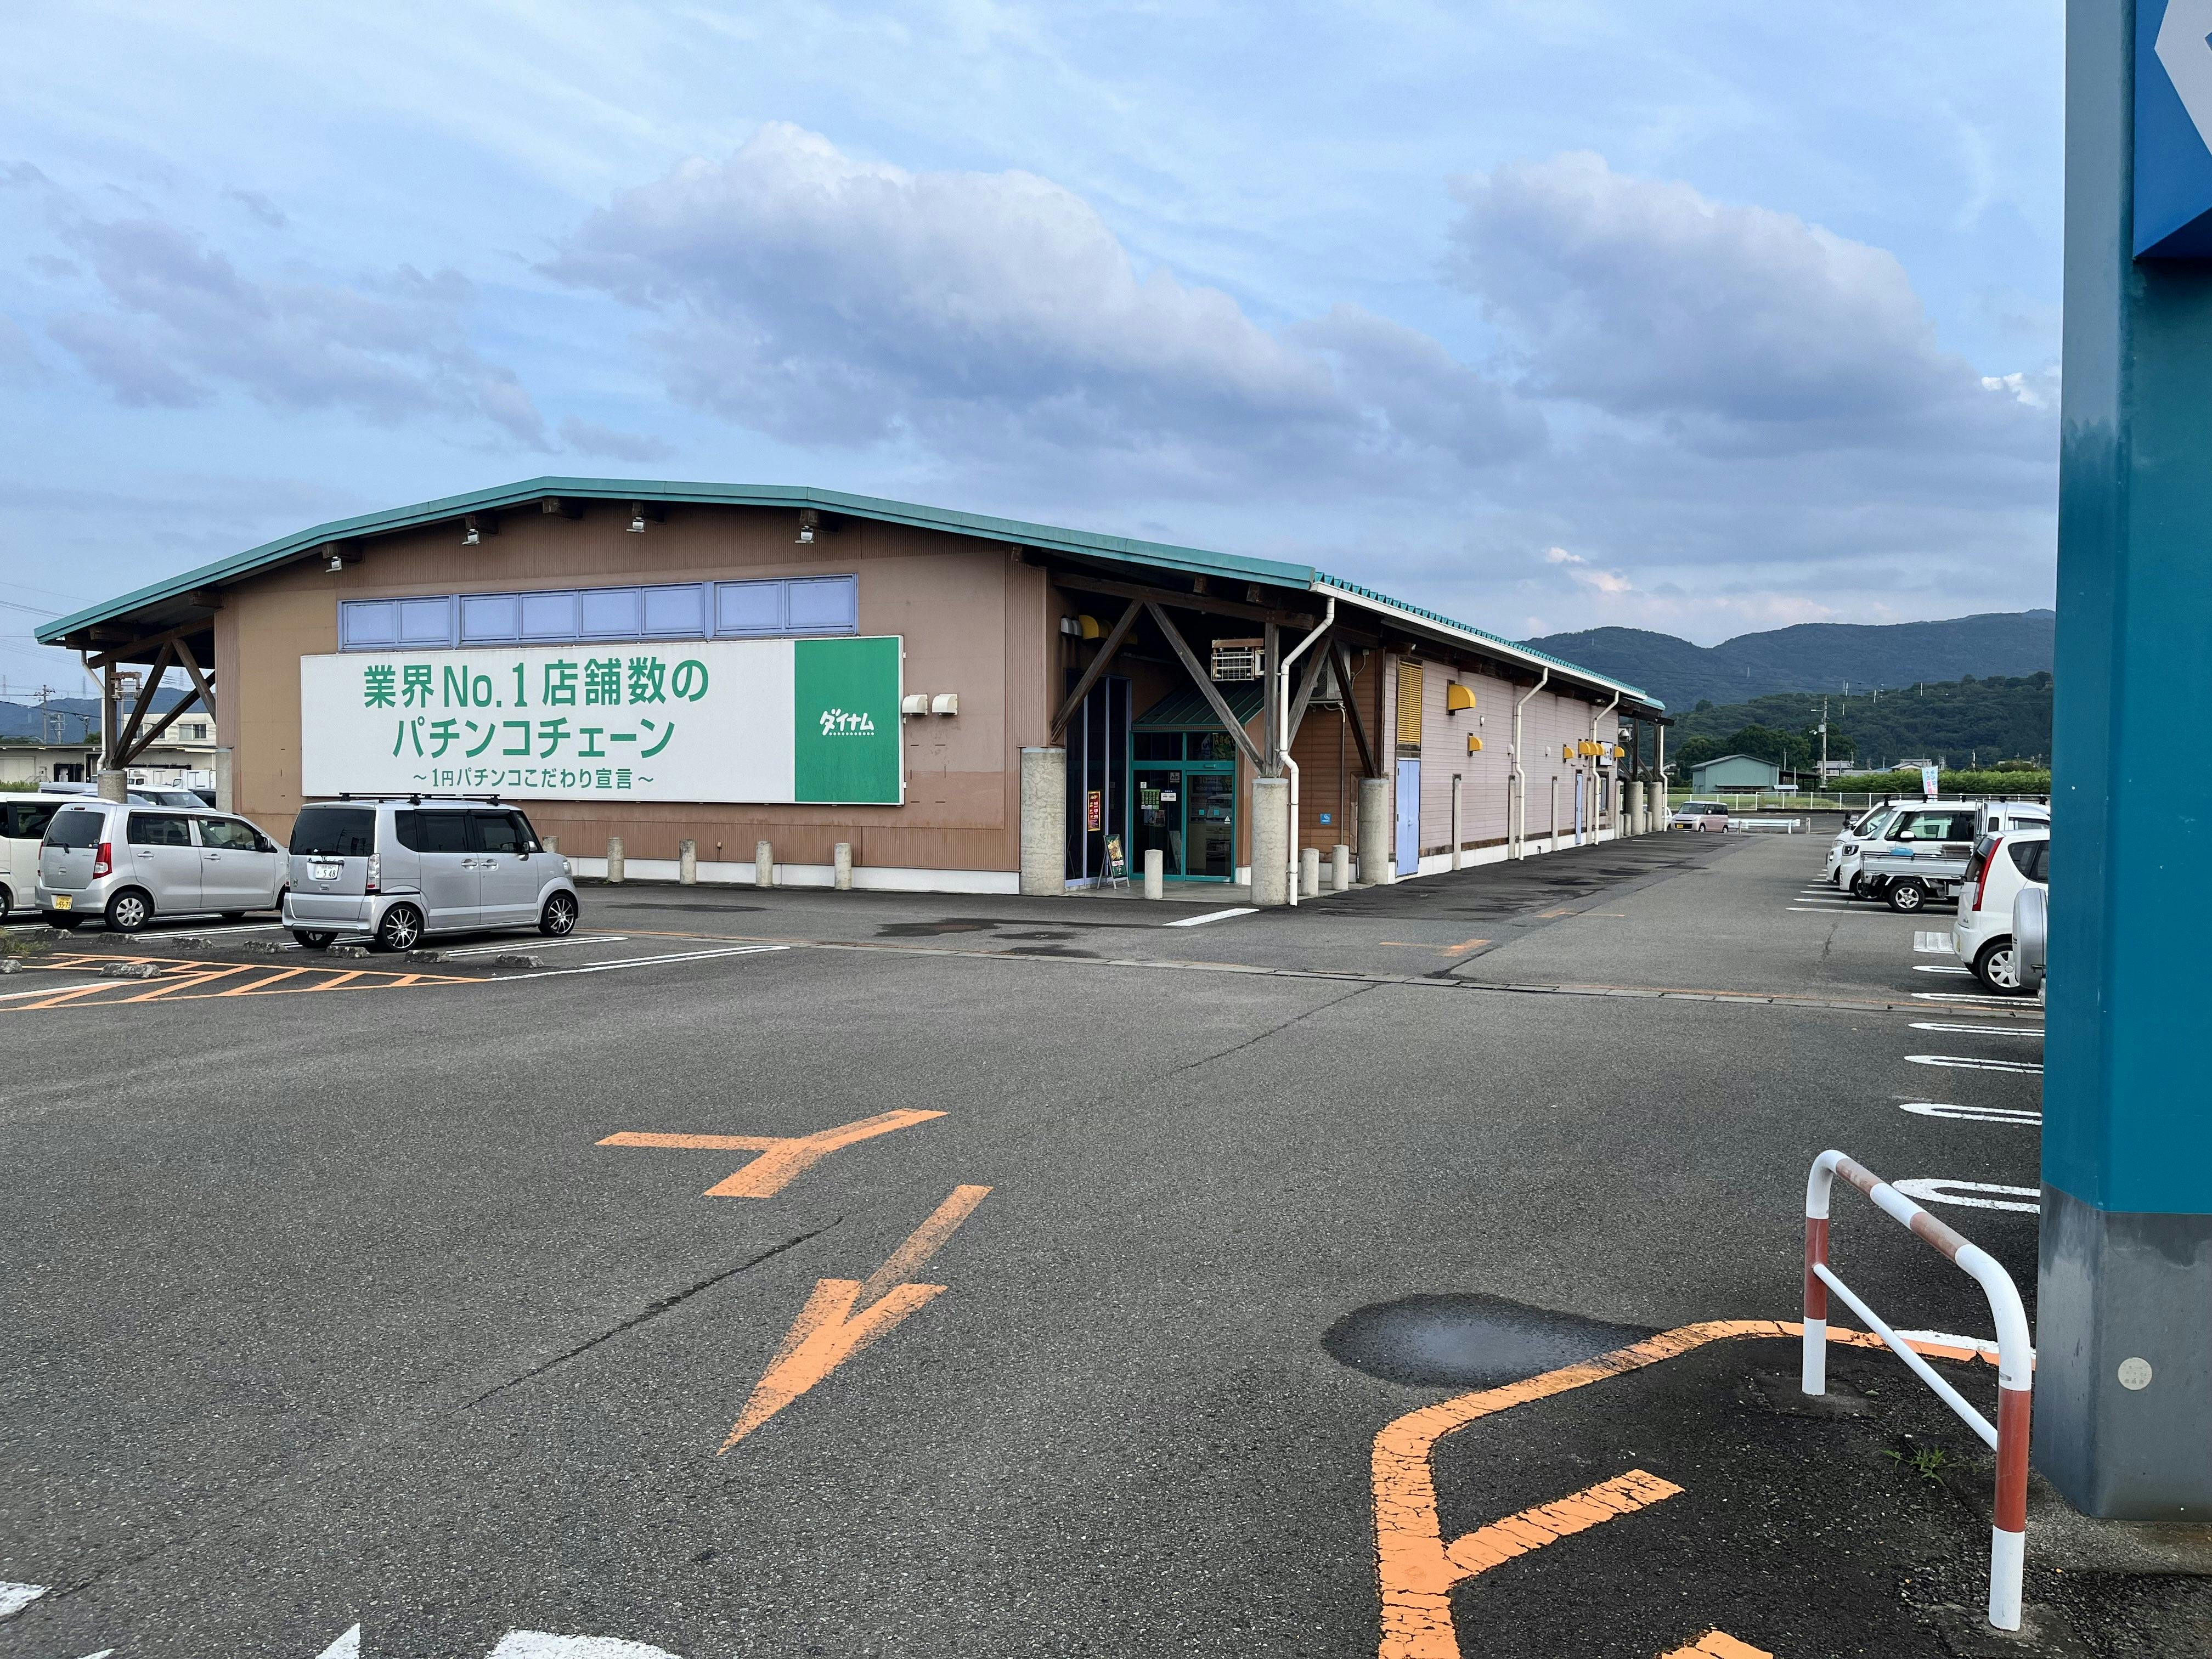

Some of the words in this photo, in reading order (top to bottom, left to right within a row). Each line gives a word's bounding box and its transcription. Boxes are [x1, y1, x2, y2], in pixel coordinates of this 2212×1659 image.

[364, 658, 709, 708] 業界No.1店舗数の
[393, 716, 675, 759] パチンコチェーン
[820, 708, 874, 735] ダイナム
